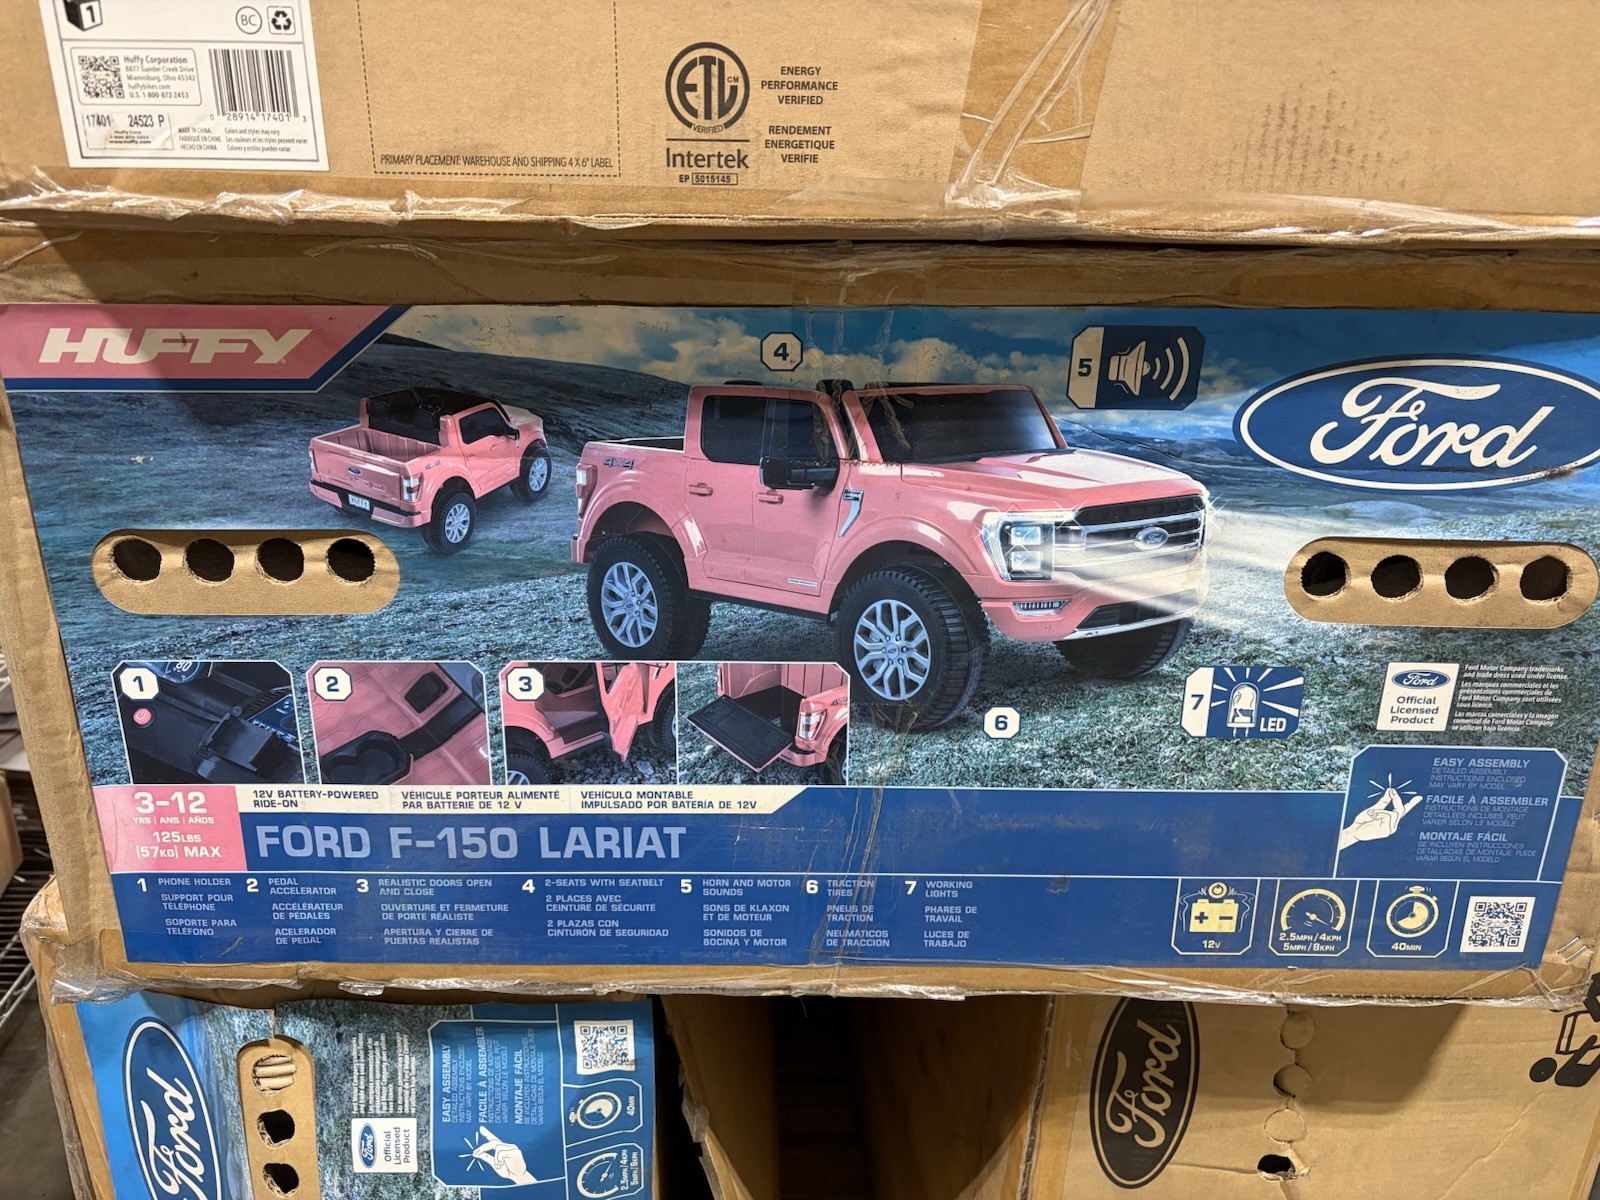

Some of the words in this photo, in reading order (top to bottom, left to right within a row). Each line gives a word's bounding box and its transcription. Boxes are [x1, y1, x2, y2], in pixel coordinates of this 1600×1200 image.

[86, 5, 95, 23] 1
[241, 14, 256, 26] BC
[124, 55, 143, 65] Huffy
[145, 55, 187, 65] Corporation
[780, 66, 822, 76] ENERGY
[677, 55, 738, 120] ETL
[761, 81, 839, 91] PERFORMANCE
[778, 95, 824, 105] VERIFIED
[86, 114, 112, 127] 17401
[128, 114, 154, 127] 24523
[158, 114, 165, 128] P
[227, 113, 256, 121] 28914
[262, 113, 290, 122] 17401
[692, 123, 724, 134] VERIFIED
[768, 125, 832, 135] RENDEMENT
[764, 139, 835, 150] ENERGETIQUE
[380, 154, 413, 165] PRIMARY
[415, 155, 461, 166] PLACEMENT:
[462, 156, 512, 167] WAREHOUSE
[512, 157, 530, 167] AND
[530, 157, 567, 167] SHIPPING
[568, 157, 574, 167] 4
[574, 157, 581, 167] X
[581, 157, 590, 167] 6"
[590, 158, 613, 168] LABEL
[666, 148, 750, 169] Intertek
[781, 153, 819, 163] VERIFIE
[679, 174, 690, 183] EP
[694, 174, 731, 184] 5015145
[39, 328, 313, 365] HUFFY
[774, 343, 789, 361] 4
[1077, 358, 1092, 377] 5
[1310, 377, 1555, 468] Ford
[1500, 665, 1528, 673] Company
[1529, 665, 1564, 673] trademarks
[133, 676, 144, 693] 1
[326, 676, 339, 693] 2
[518, 676, 532, 693] 3
[1402, 672, 1439, 686] Ford
[1190, 694, 1205, 709] 7
[1397, 696, 1436, 705] Official
[1390, 706, 1439, 714] Licensed
[994, 715, 1009, 732] 6
[1260, 717, 1287, 733] LED
[1390, 716, 1434, 724] Product
[1433, 757, 1465, 767] EASY
[1468, 758, 1530, 769] ASSEMBLY
[253, 790, 273, 798] 12V
[278, 790, 379, 800] BATTERY-POWERED
[401, 789, 452, 800] VÉHICULE
[456, 791, 504, 800] PORTEUR
[507, 789, 560, 800] ALIMENTÉ
[581, 789, 632, 800] VEHÍCULO
[636, 790, 694, 800] MONTABLE
[1426, 795, 1465, 805] FACILE
[1467, 794, 1477, 805] À
[1480, 796, 1549, 806] ASSEMBLER
[134, 791, 208, 814] 3-12
[253, 799, 299, 808] RIDE-ON
[402, 801, 422, 810] PAR
[427, 801, 475, 810] BATTERIE
[479, 801, 493, 810] DE
[497, 801, 510, 810] 12
[514, 801, 522, 809] V
[581, 800, 643, 809] IMPULSADO
[647, 800, 668, 809] POR
[672, 799, 714, 809] BATERÍA
[719, 800, 732, 809] DE
[737, 800, 757, 809] 12V
[132, 816, 152, 824] YRS
[159, 816, 180, 824] ANS
[188, 815, 215, 824] AÑOS
[153, 831, 202, 843] 125LBS
[1419, 831, 1474, 841] MONTAJE
[1477, 830, 1508, 842] FÁCIL
[256, 825, 371, 859] FORD
[389, 826, 518, 860] F-150
[539, 826, 687, 859] LARIAT
[184, 846, 222, 858] MAX
[137, 878, 148, 893] 1
[158, 877, 191, 886] PHONE
[194, 878, 231, 886] HOLDER
[246, 878, 259, 893] 2
[268, 878, 299, 886] PEDAL
[356, 878, 370, 893] 3
[378, 878, 426, 887] REALISTIC
[429, 879, 463, 887] DOORS
[466, 879, 493, 887] OPEN
[521, 879, 536, 893] 4
[545, 879, 587, 887] 2-SEATS
[590, 879, 616, 887] WITH
[618, 879, 664, 887] SEATBELT
[680, 879, 693, 893] 5
[702, 879, 729, 887] HORN
[732, 879, 754, 887] AND
[757, 879, 791, 887] MOTOR
[806, 880, 819, 894] 6
[827, 880, 875, 888] TRACTION
[904, 880, 918, 895] 7
[925, 881, 974, 889] WORKING
[269, 887, 337, 895] ACCELERATOR
[379, 888, 401, 896] AND
[403, 888, 435, 896] CLOSE
[702, 888, 744, 896] SOUNDS
[827, 889, 853, 897] TIRES
[925, 890, 959, 898] LIGHTS
[161, 894, 204, 902] SUPPORT
[207, 894, 234, 902] POUR
[545, 895, 552, 903] 2
[556, 895, 593, 903] PLACES
[596, 894, 622, 903] AVEC
[546, 904, 592, 912] CEINTURE
[595, 904, 608, 912] DE
[611, 903, 656, 912] SÉCURITÉ
[165, 918, 208, 927] SOPORTE
[211, 919, 237, 927] PARA
[547, 920, 554, 928] 2
[557, 920, 595, 928] PLAZAS
[598, 920, 620, 928] CON
[547, 928, 597, 937] CINTURÓN
[600, 929, 612, 937] DE
[615, 929, 670, 937] SEGURIDAD
[1202, 939, 1222, 949] 12V
[1391, 942, 1422, 951] 40MIN
[476, 1026, 487, 1077] ASSEMBLER
[442, 1044, 451, 1093] ASSEMBLY
[513, 1050, 523, 1075] FÁCIL
[1105, 1019, 1182, 1148] Ford
[479, 1091, 488, 1123] FACILE
[514, 1078, 523, 1124] MONTAJE
[627, 1095, 636, 1117] 40MIN
[442, 1097, 451, 1123] EASY
[140, 1067, 208, 1200] Ford
[361, 1133, 375, 1160] Ford
[384, 1130, 392, 1162] Official
[394, 1127, 402, 1165] Licensed
[403, 1129, 411, 1164] Product
